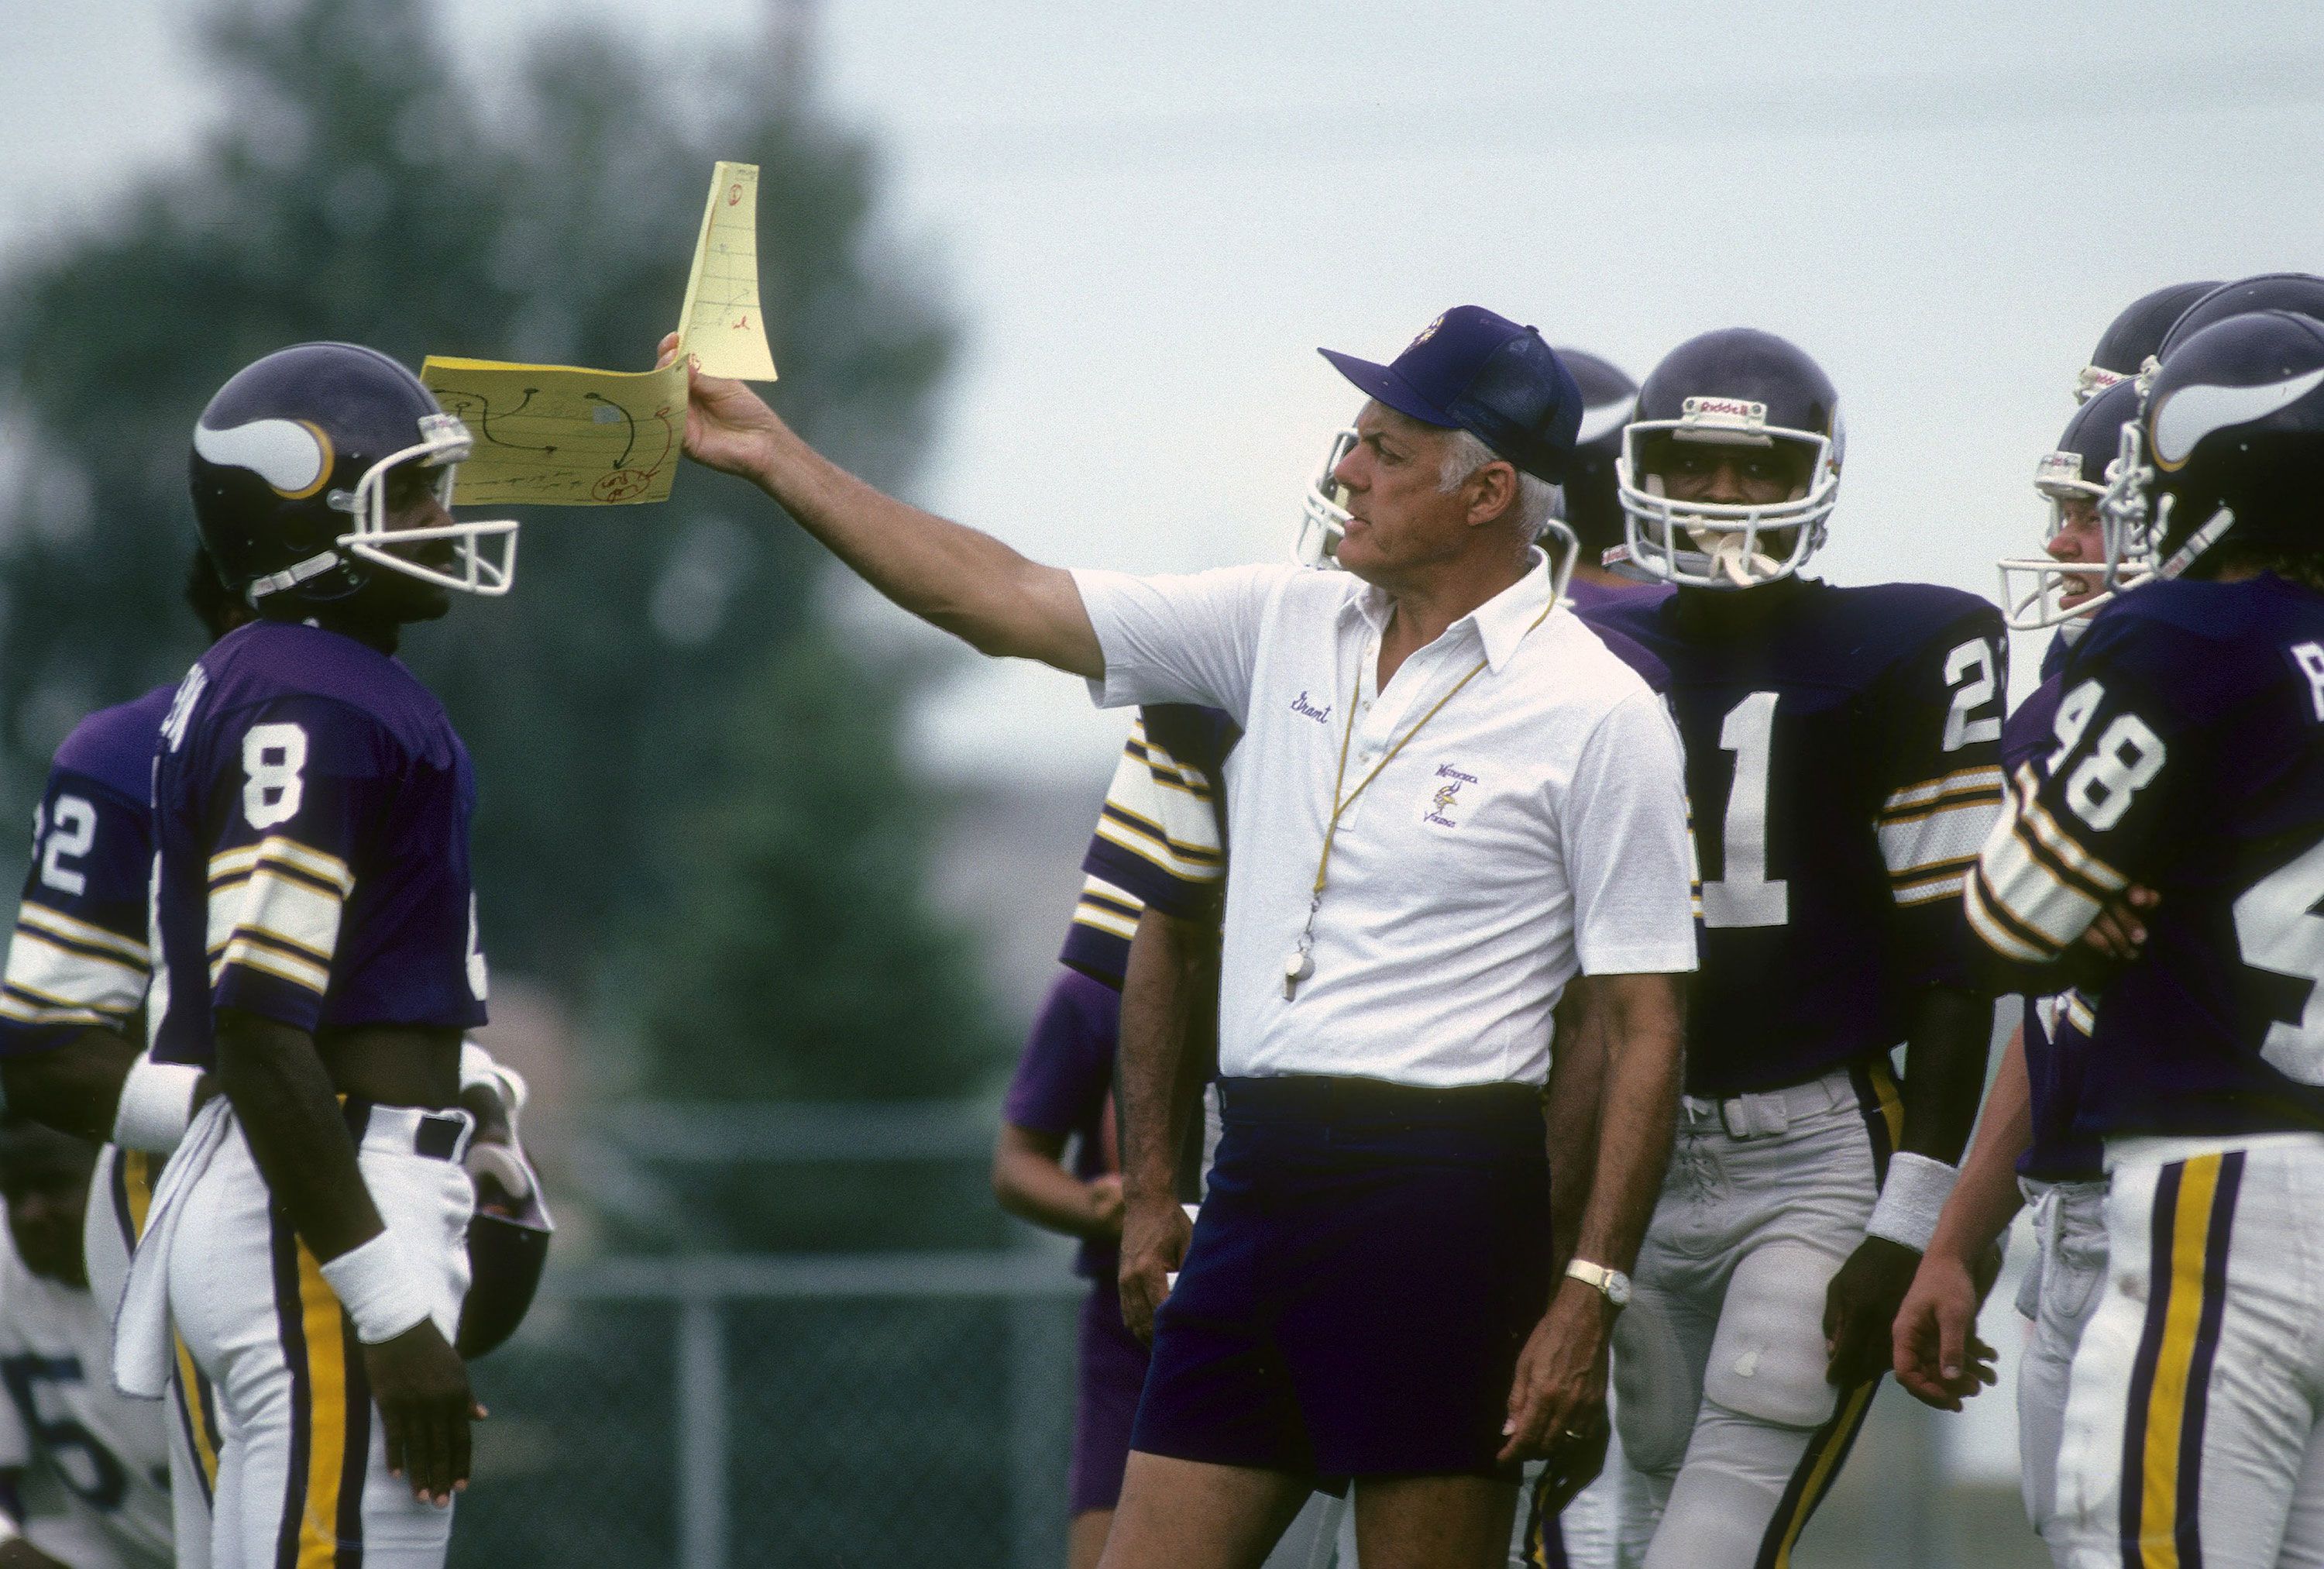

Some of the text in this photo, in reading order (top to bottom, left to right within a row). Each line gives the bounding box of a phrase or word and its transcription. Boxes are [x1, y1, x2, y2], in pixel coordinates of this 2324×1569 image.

[1700, 401, 1748, 416] Riddell
[1291, 690, 1332, 724] Grant
[1942, 637, 2006, 752] 2
[242, 722, 307, 830] 8
[1703, 691, 1788, 928] 1
[33, 794, 98, 896] 2
